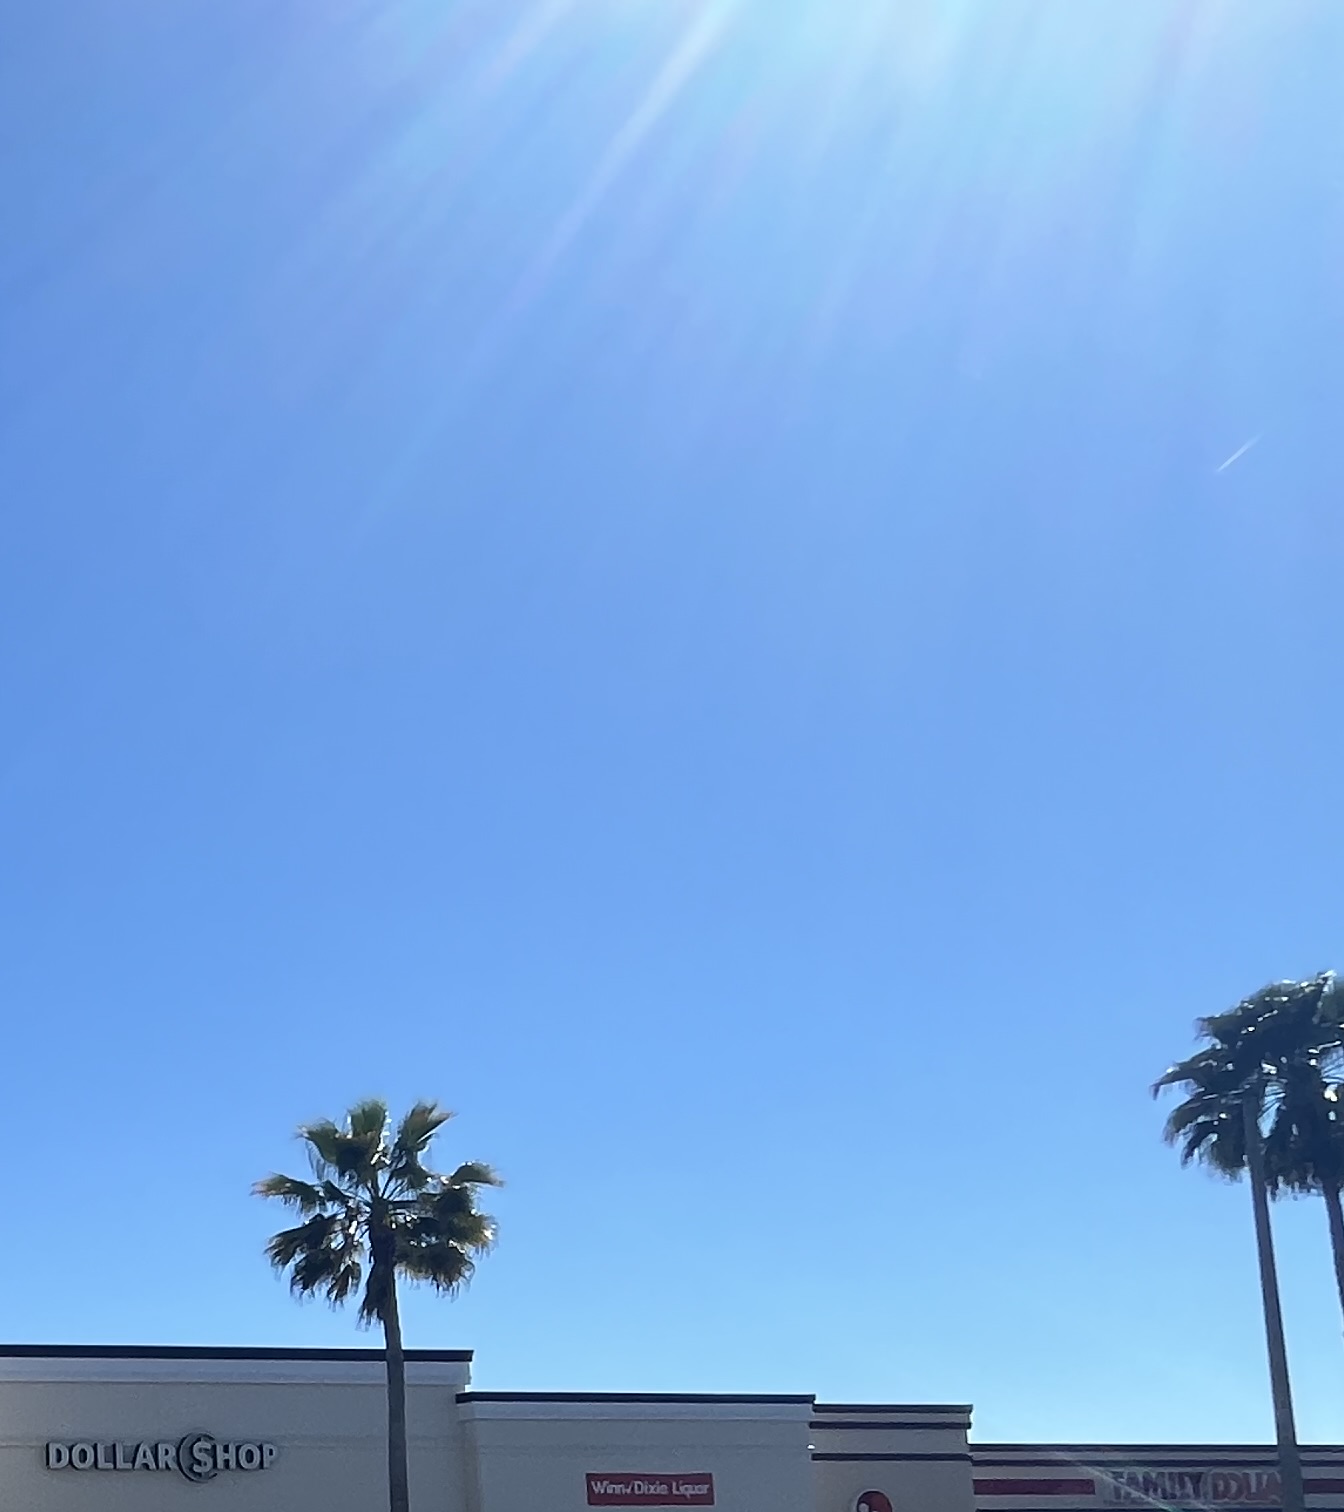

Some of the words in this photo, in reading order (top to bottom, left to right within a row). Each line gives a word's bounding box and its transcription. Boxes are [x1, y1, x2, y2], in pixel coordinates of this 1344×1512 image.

[46, 1442, 178, 1470] DOLLAR
[591, 1480, 625, 1495] Winn
[634, 1480, 669, 1495] Dixie
[672, 1480, 710, 1499] Liquor
[1112, 1472, 1204, 1501] FAMILY
[1211, 1472, 1283, 1501] DOLLA
